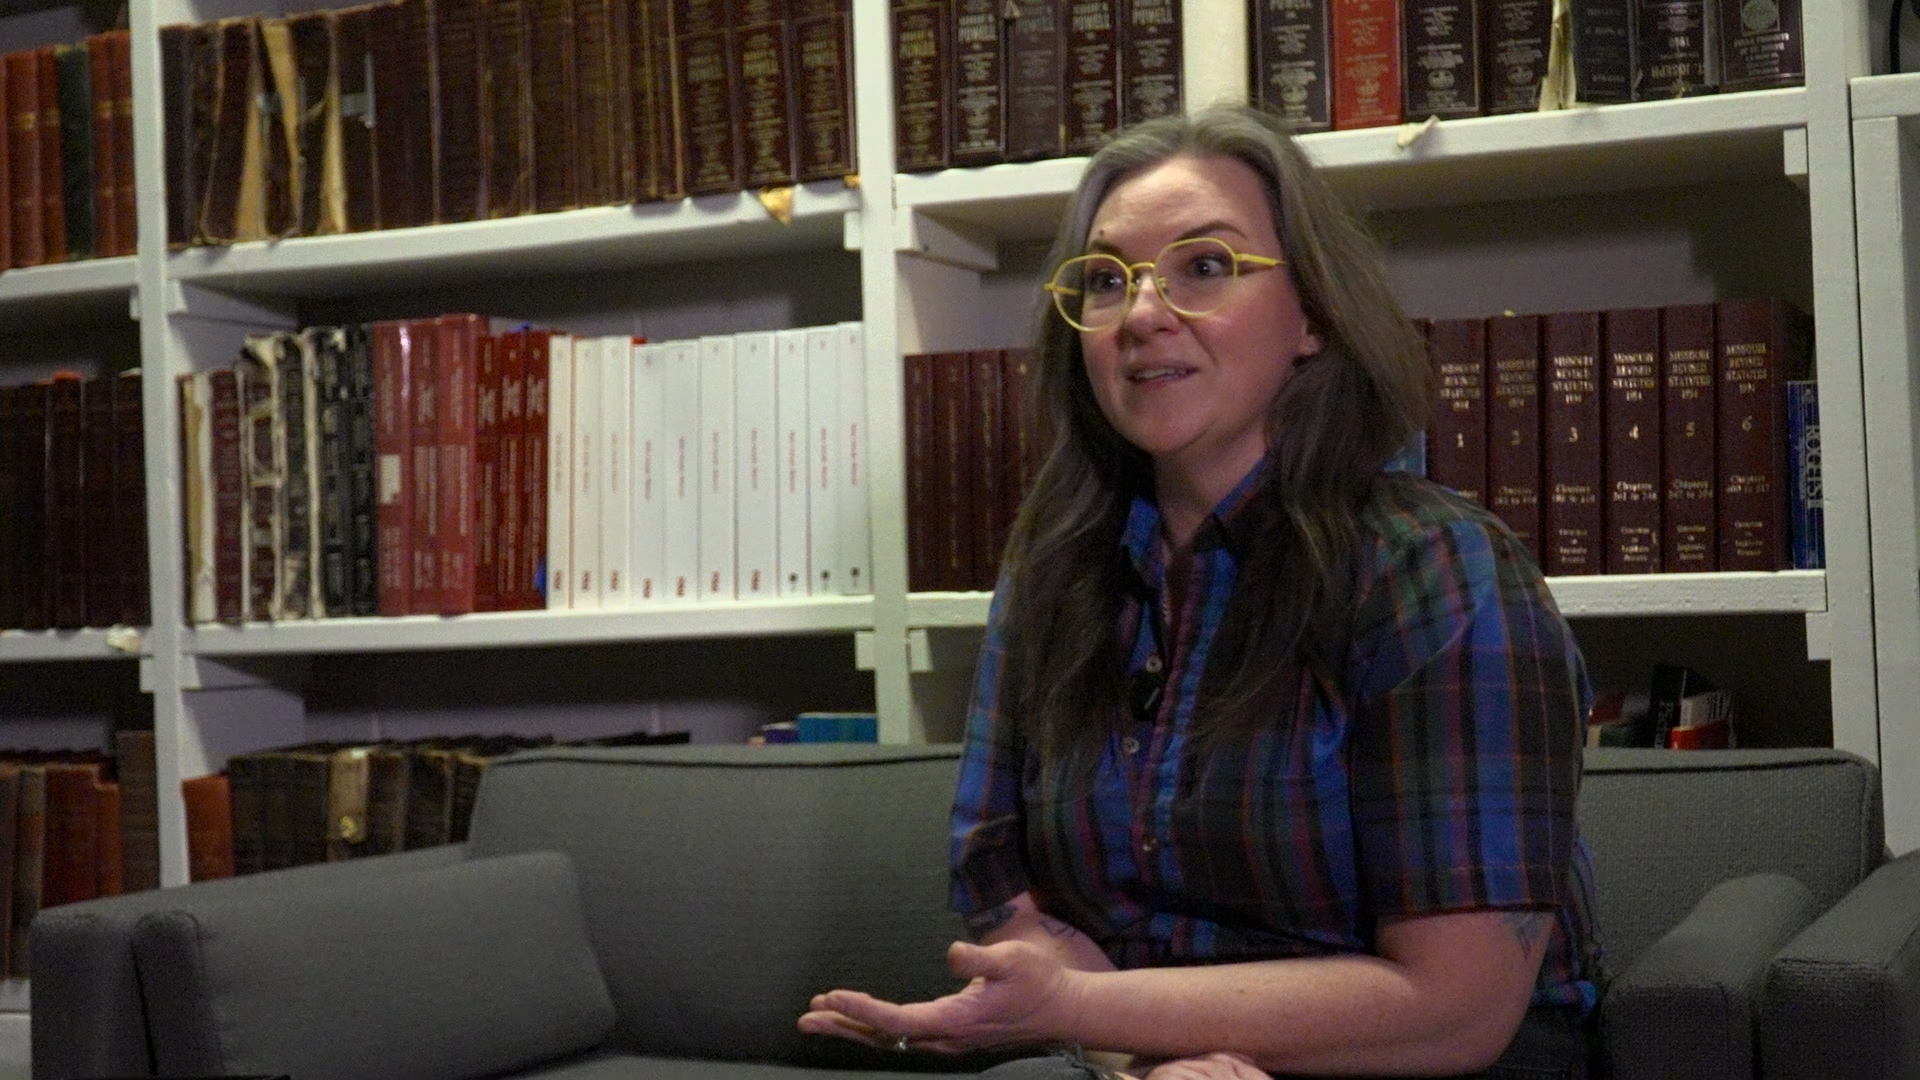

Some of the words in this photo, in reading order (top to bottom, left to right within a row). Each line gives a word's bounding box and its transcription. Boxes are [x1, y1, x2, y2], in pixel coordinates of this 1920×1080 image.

[1669, 350, 1710, 361] MISSOURI
[1726, 343, 1766, 355] MISSOURI
[1729, 357, 1764, 368] REVISED
[1726, 369, 1767, 381] STATUTES
[1686, 421, 1695, 437] 5
[1742, 415, 1752, 432] 6
[1569, 426, 1578, 443] 3
[1629, 424, 1639, 439] 4
